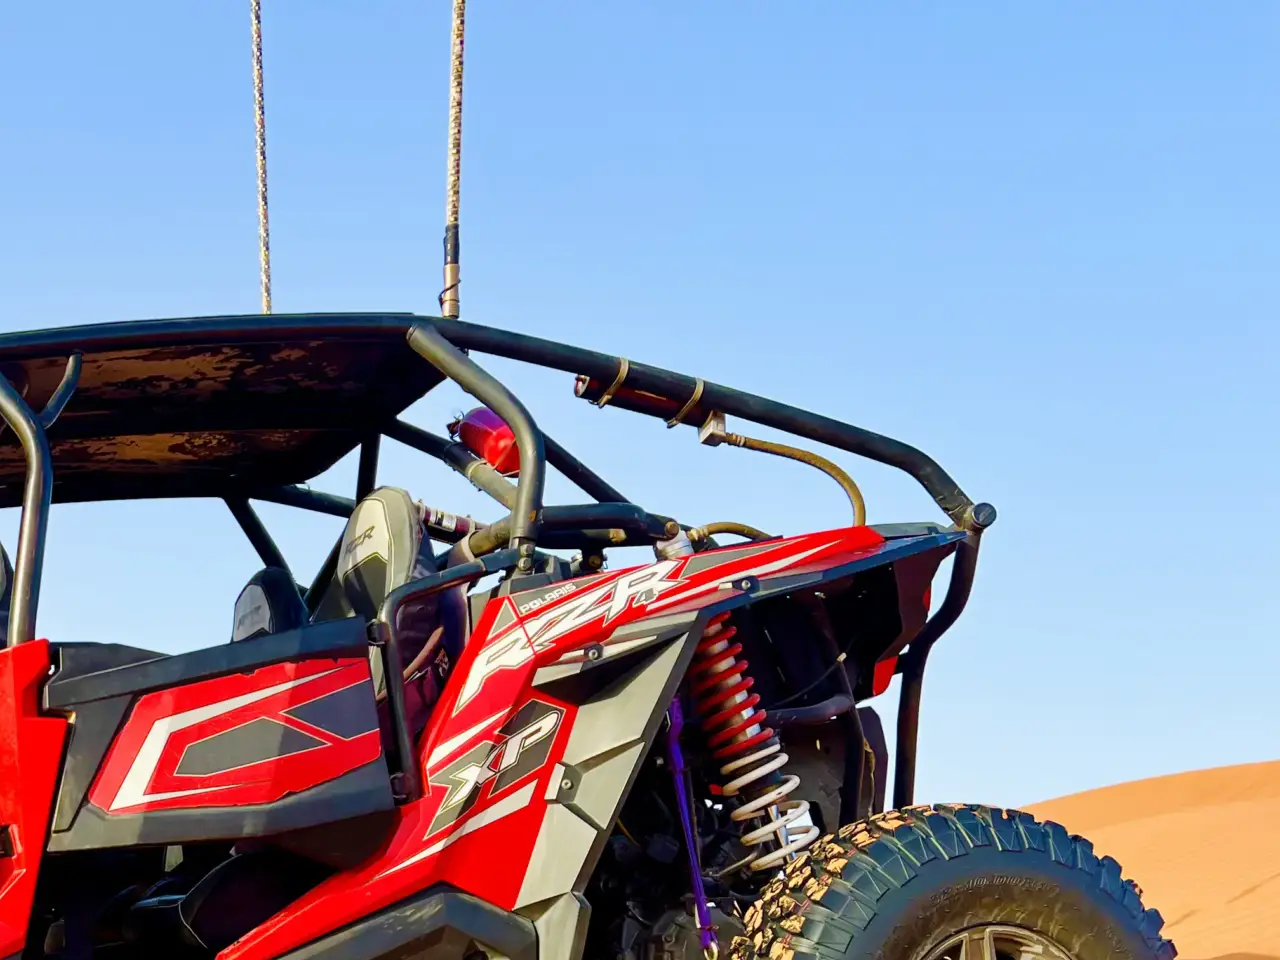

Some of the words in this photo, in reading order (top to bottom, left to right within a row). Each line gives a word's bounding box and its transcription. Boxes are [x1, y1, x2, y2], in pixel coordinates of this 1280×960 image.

[451, 556, 690, 717] RZR
[632, 585, 659, 607] 4
[519, 582, 576, 613] POLARIS
[438, 711, 561, 815] XP
